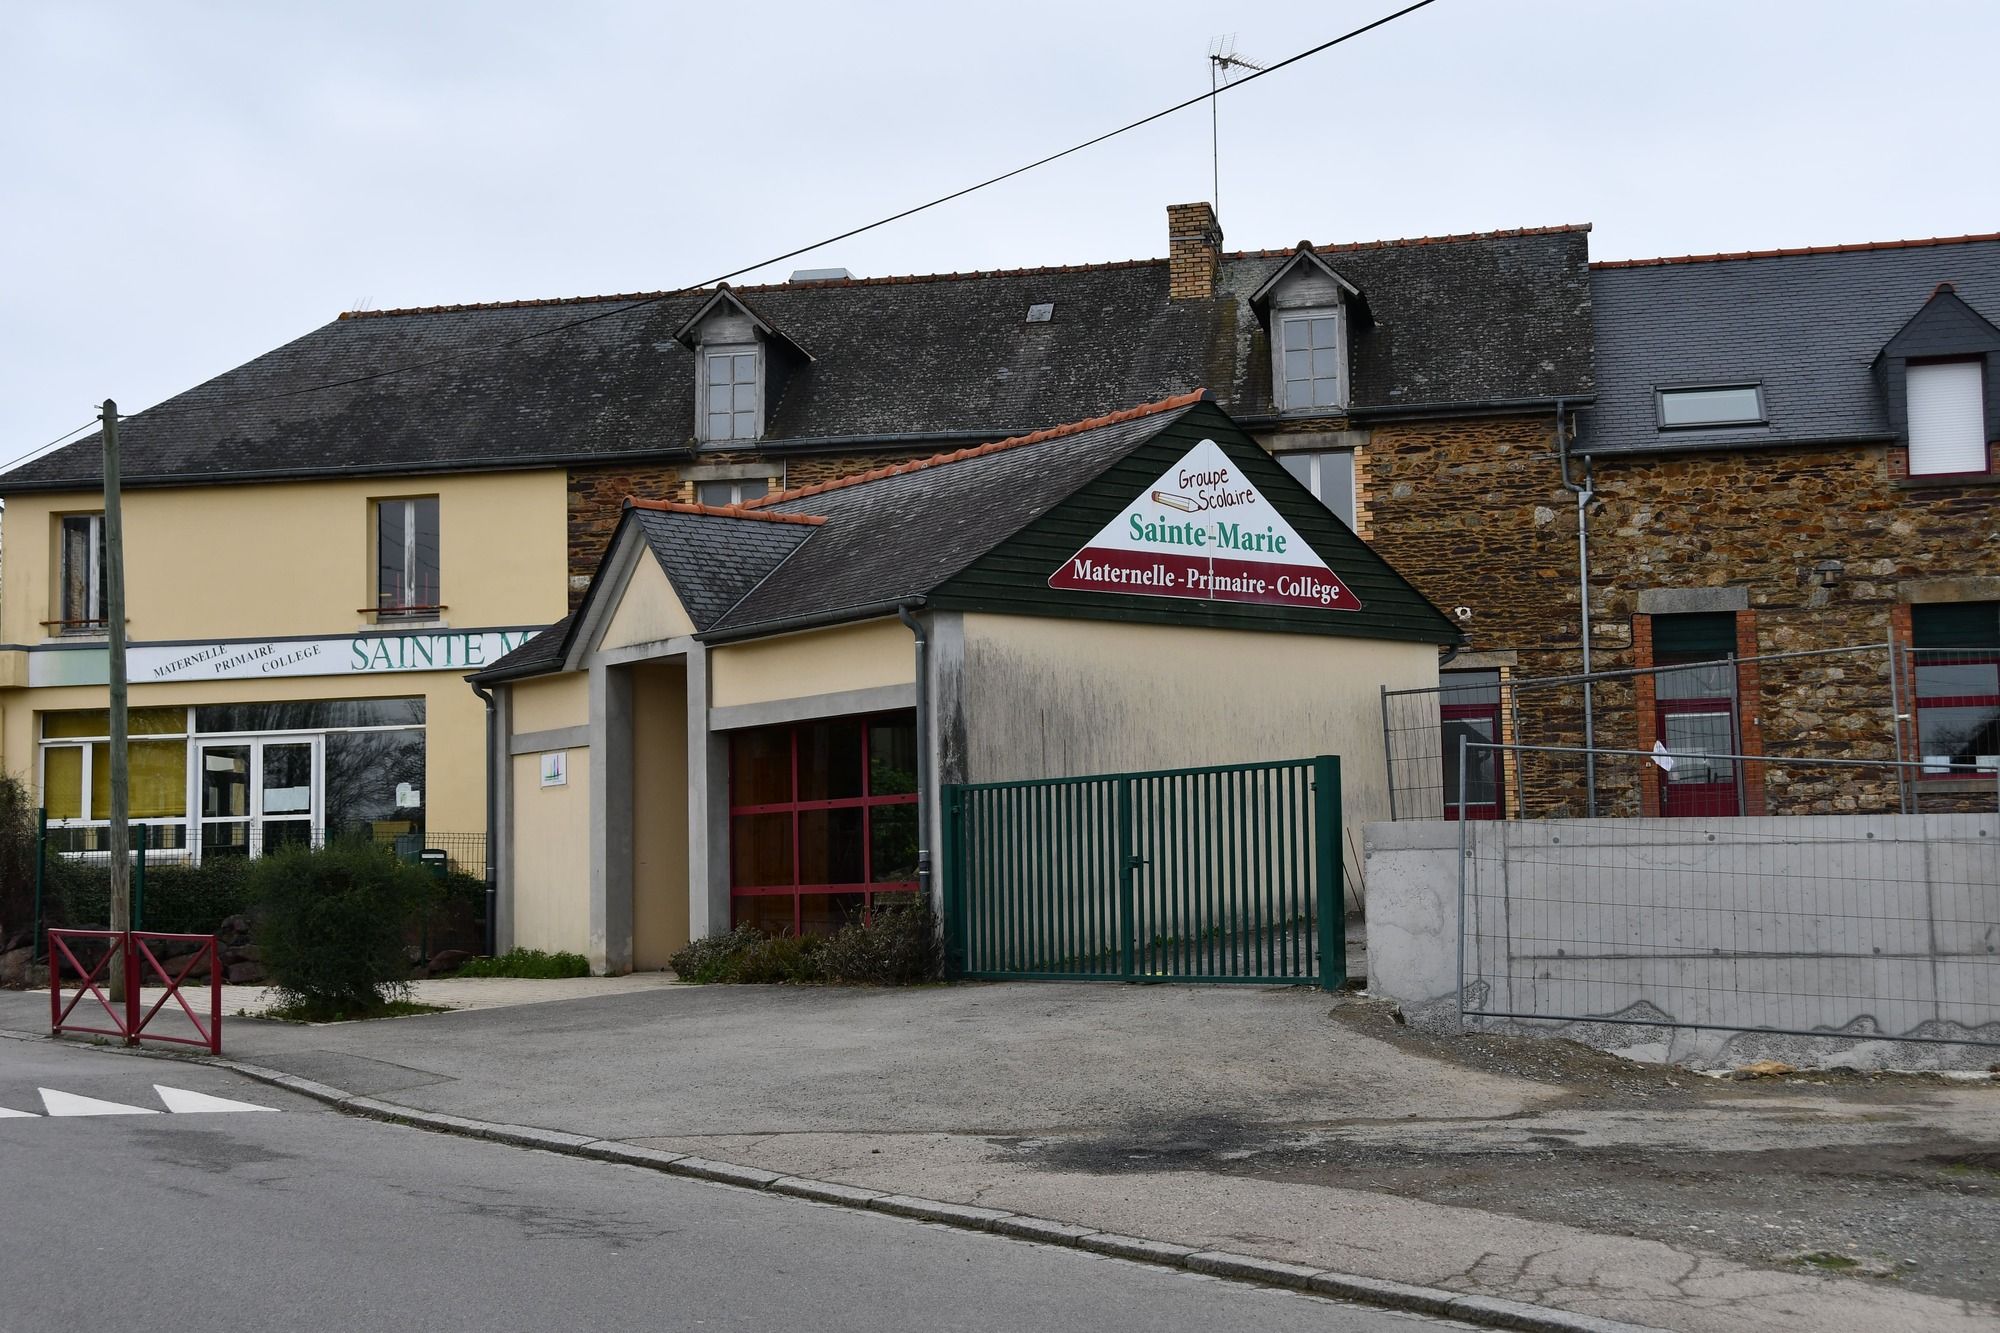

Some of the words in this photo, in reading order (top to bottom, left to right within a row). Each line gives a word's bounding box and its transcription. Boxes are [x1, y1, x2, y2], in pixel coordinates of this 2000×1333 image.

[1178, 468, 1229, 490] Groupe
[1198, 488, 1255, 510] Scolaire
[1129, 513, 1287, 553] Sainte-Marie
[153, 644, 228, 679] MATERNELLE
[214, 643, 276, 673] PRIMAIRE
[261, 644, 322, 673] COLLEGE
[351, 632, 486, 671] SAINTE
